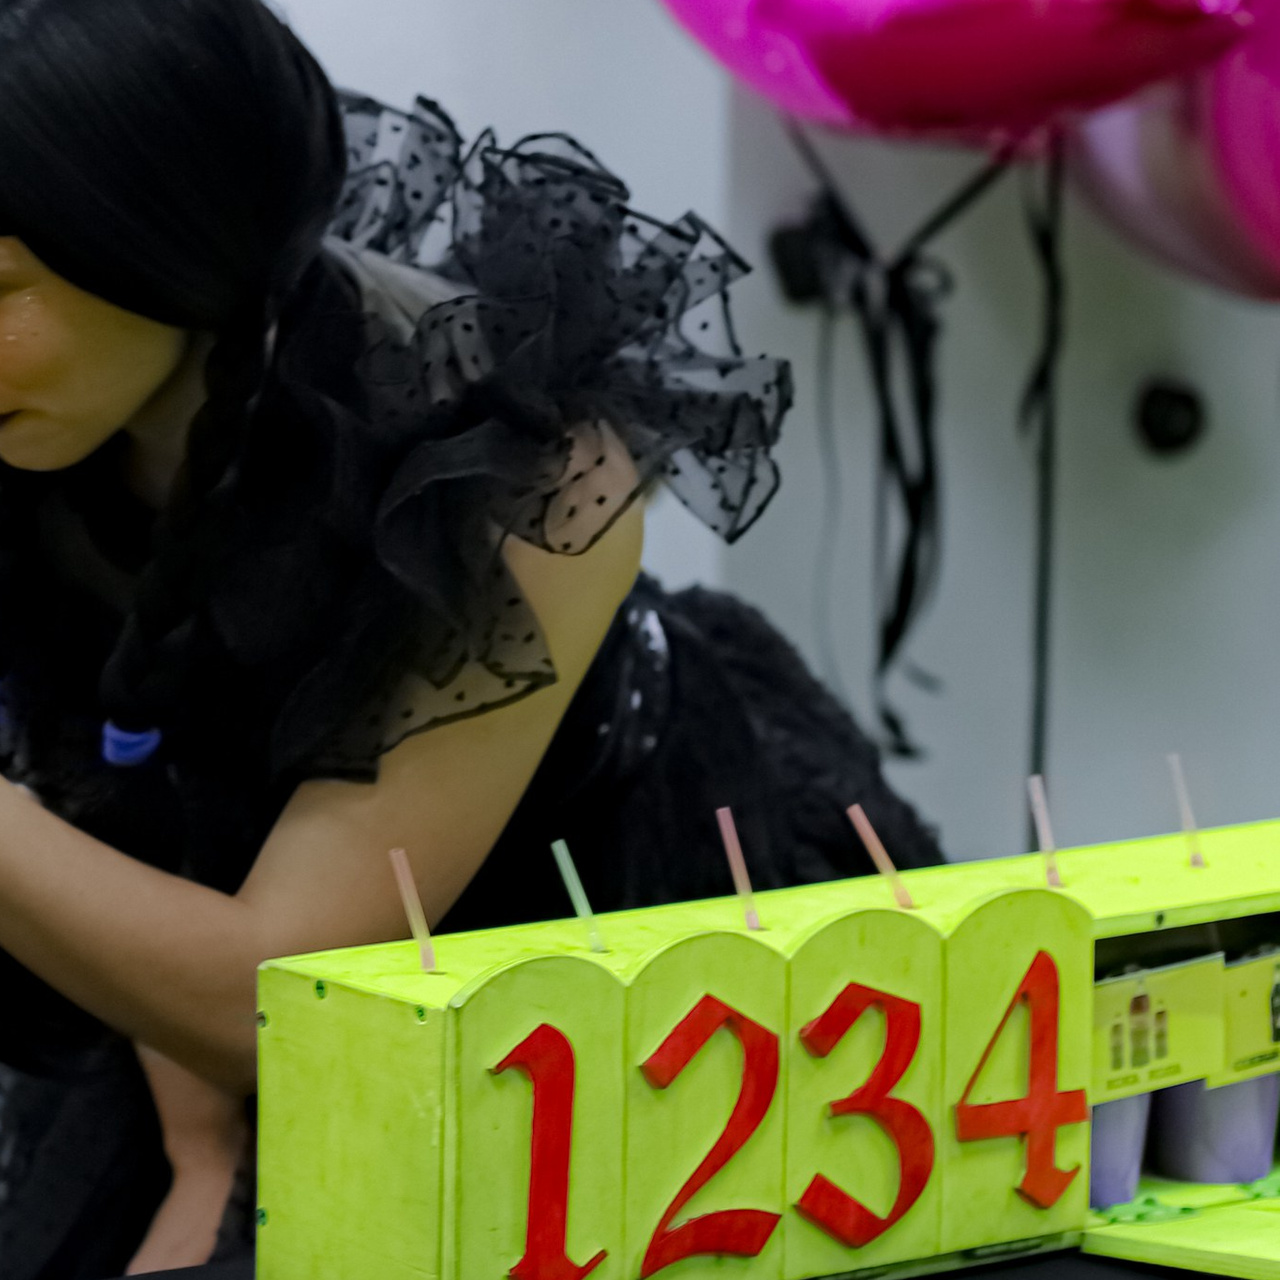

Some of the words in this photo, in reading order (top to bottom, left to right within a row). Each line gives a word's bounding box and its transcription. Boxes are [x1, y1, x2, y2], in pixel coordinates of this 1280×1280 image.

[639, 993, 781, 1280] 2
[794, 982, 935, 1248] 3
[955, 949, 1088, 1210] 4
